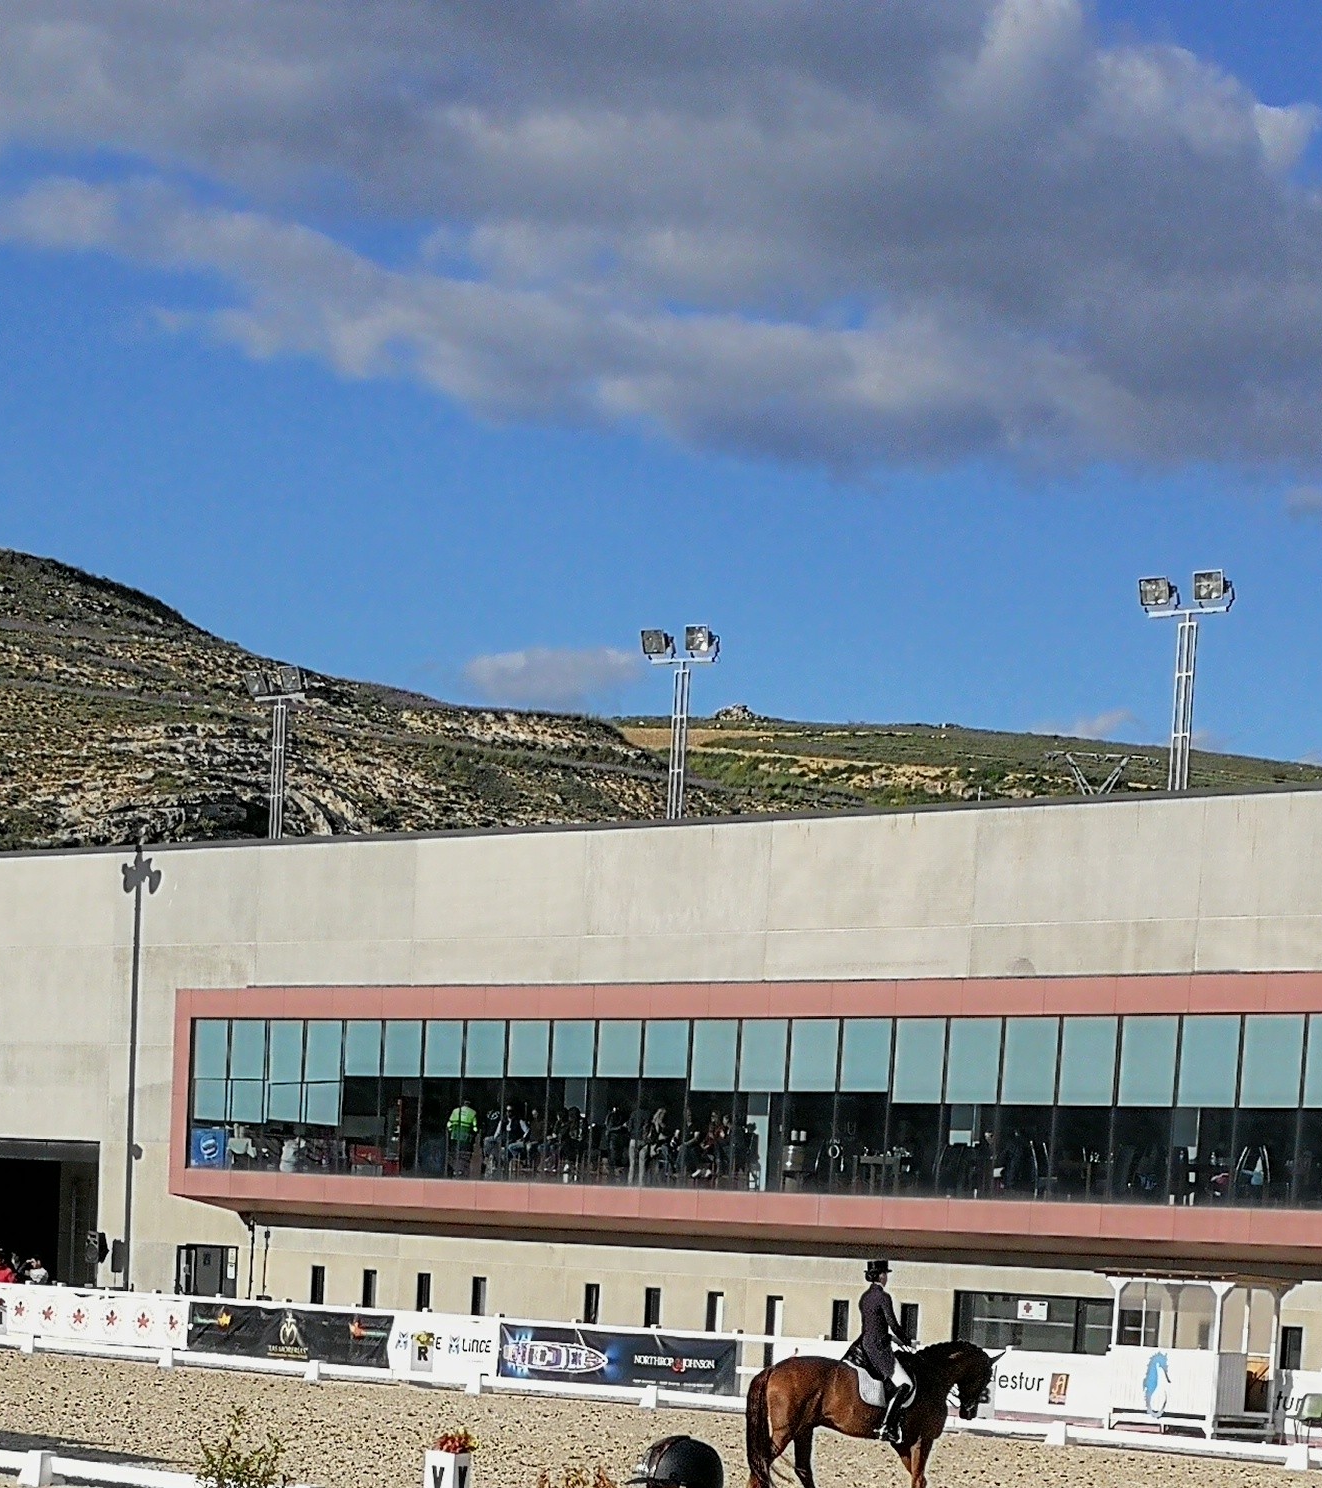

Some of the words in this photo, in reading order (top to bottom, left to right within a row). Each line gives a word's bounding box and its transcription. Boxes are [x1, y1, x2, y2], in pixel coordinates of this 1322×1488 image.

[417, 1346, 429, 1361] R
[634, 1355, 674, 1367] NORTHROP
[681, 1358, 715, 1372] JOHNSON
